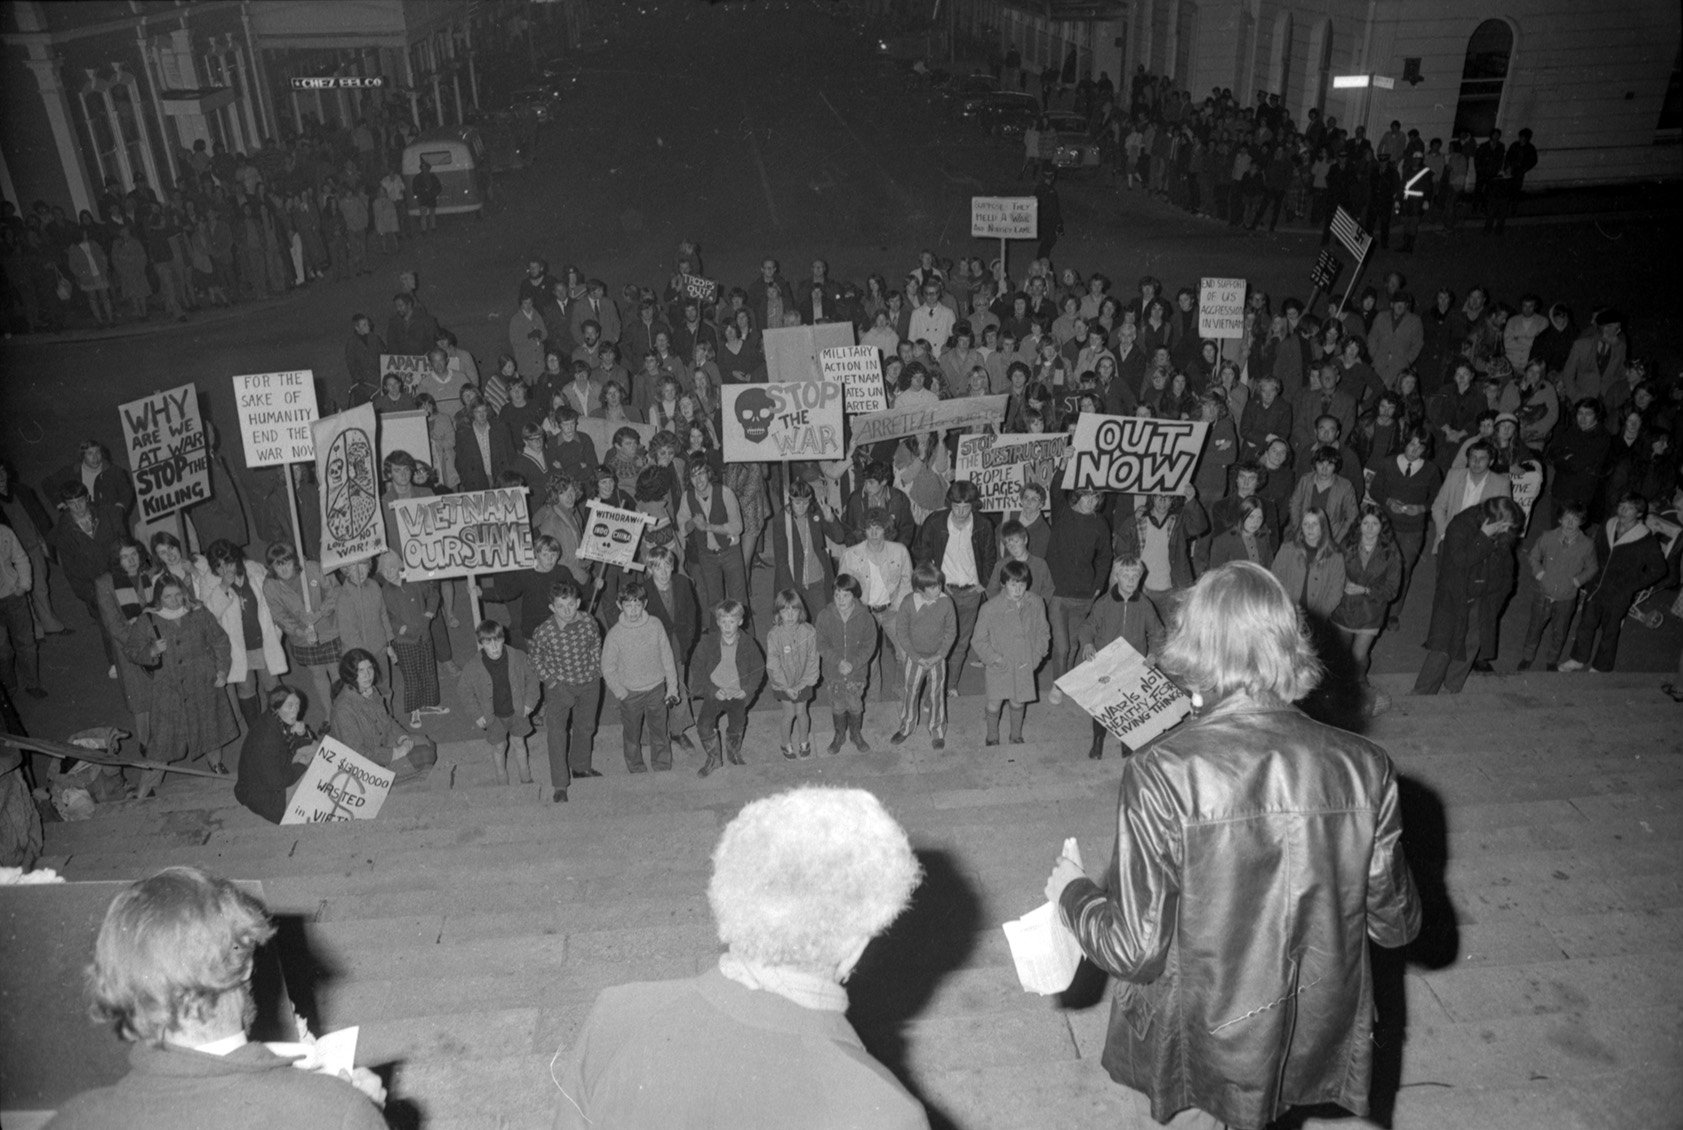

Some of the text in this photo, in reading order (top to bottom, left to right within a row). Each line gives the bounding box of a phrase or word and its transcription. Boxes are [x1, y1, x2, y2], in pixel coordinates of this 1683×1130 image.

[301, 79, 336, 89] CHEZ
[1001, 212, 1007, 222] A
[682, 273, 714, 289] TROOPS
[1201, 279, 1245, 289] END SUPPORT
[1207, 291, 1237, 302] OF US
[1201, 304, 1244, 315] AGGRESSION
[1202, 318, 1245, 329] IN VIETNAM
[823, 347, 872, 359] MILITARY
[387, 356, 433, 372] APATH
[825, 360, 878, 373] ACTION IN
[244, 371, 303, 390] FOR THE
[241, 390, 301, 408] SAKE OF
[765, 381, 841, 415] STOP
[846, 387, 884, 398] ATES UN
[124, 387, 188, 434] WHY
[846, 400, 880, 412] ARTER
[249, 407, 312, 425] HUMANITY
[778, 409, 810, 430] THE
[132, 417, 194, 451] ARE WE
[252, 426, 309, 444] END THE
[771, 425, 839, 457] WAR
[1095, 419, 1194, 456] OUT
[138, 431, 204, 470] AT WAR
[256, 446, 283, 461] WAR
[960, 435, 1070, 471] THE DESTRUCTION
[961, 433, 999, 456] STOP
[136, 454, 208, 496] STOP THE
[970, 467, 1013, 486] PEOPLE
[1073, 450, 1197, 492] NOW
[979, 480, 1022, 498] LLAGES
[142, 481, 204, 517] KILLING
[399, 489, 527, 537] VIETNAM
[360, 522, 379, 540] NOT
[336, 541, 369, 558] WAR!
[1095, 700, 1129, 723] WAR
[1140, 663, 1163, 693] NOT
[1106, 681, 1178, 732] HEALTHY FOR
[1114, 689, 1185, 738] LIVING THINGS
[318, 746, 337, 764] NZ
[316, 778, 366, 808] WASTED
[294, 804, 306, 818] in
